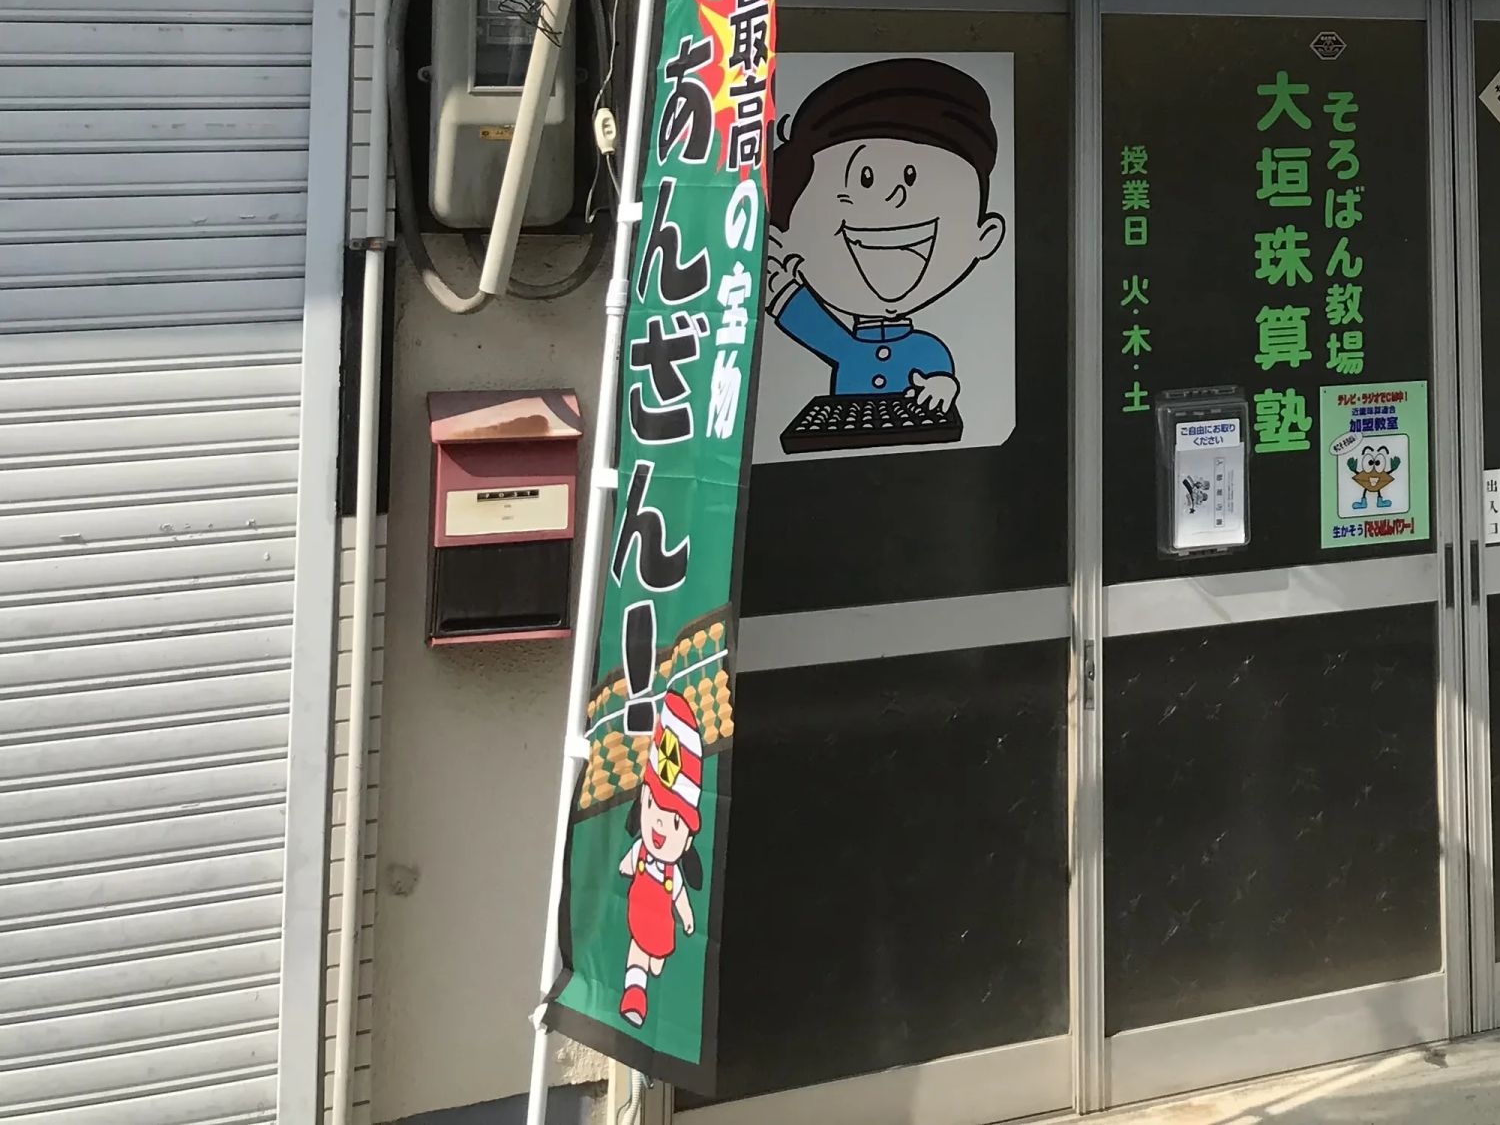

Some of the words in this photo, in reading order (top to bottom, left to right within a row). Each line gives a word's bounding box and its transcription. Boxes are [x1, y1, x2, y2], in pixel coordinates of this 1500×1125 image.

[1120, 145, 1151, 247] 授業日
[1323, 91, 1365, 376] そろばん教場
[1254, 70, 1314, 454] 大垣珠算塾
[610, 33, 717, 736] あんざん!
[1180, 423, 1236, 436] ご自由にお取り
[1193, 435, 1224, 446] ください
[1349, 416, 1399, 433] 加盟教室
[1486, 479, 1499, 535] 出入口
